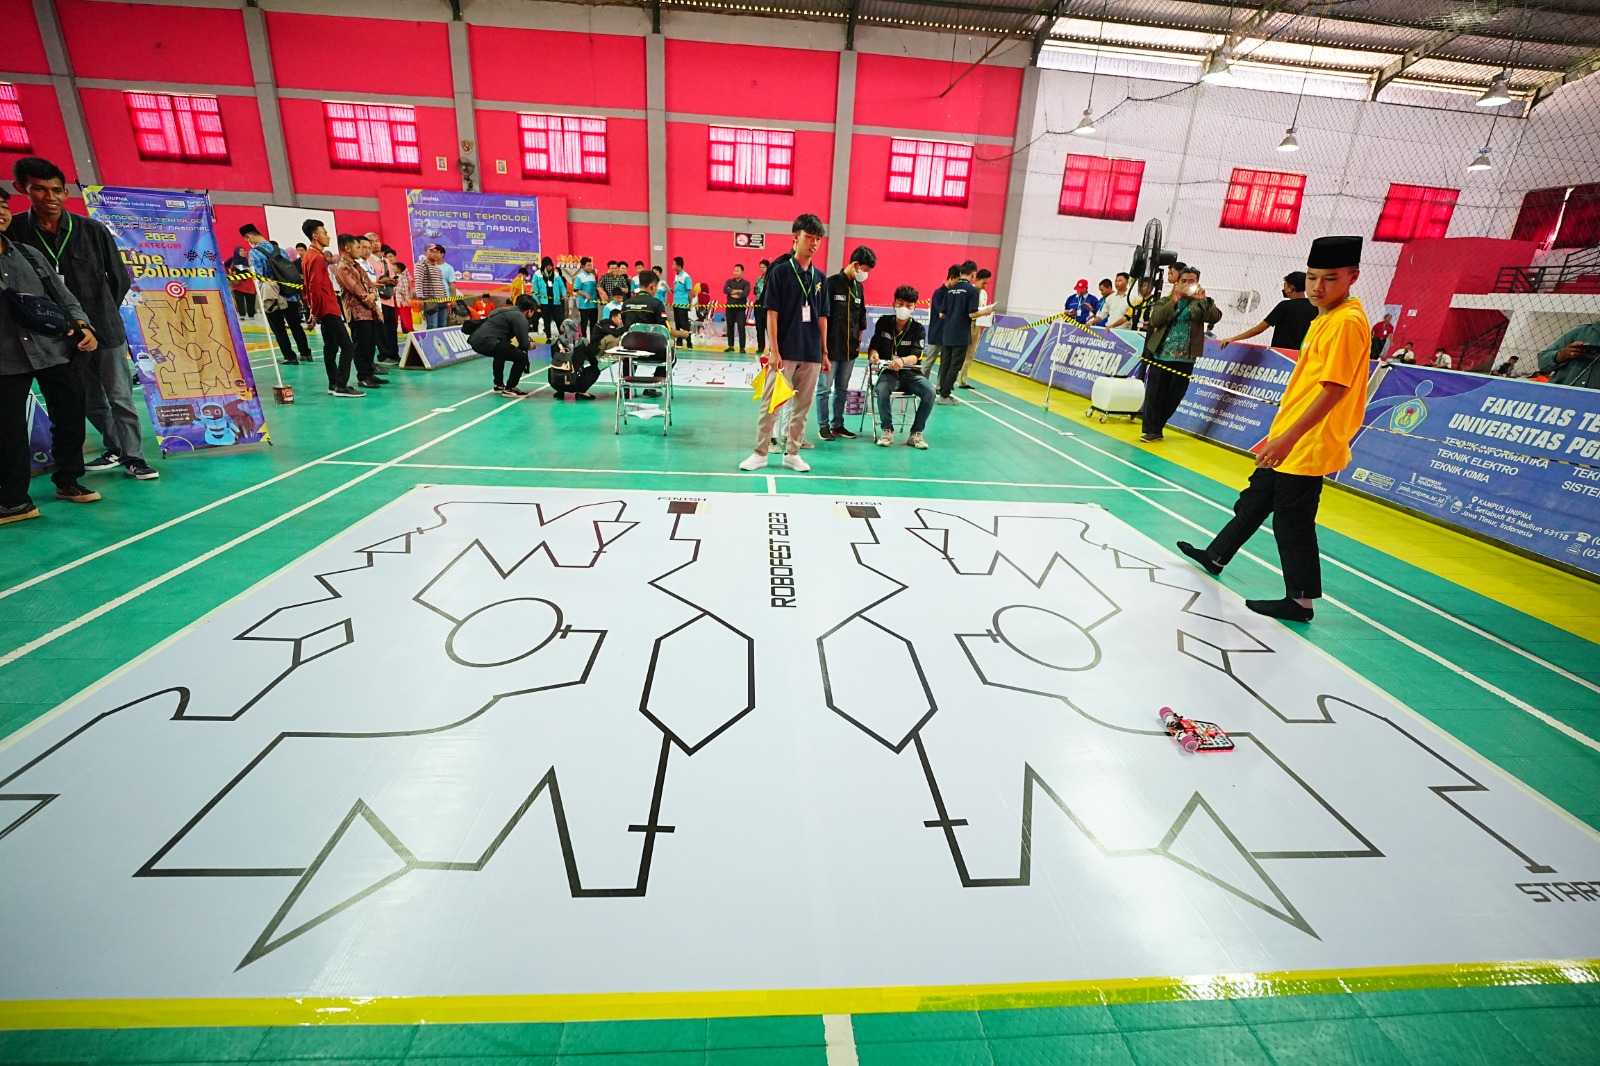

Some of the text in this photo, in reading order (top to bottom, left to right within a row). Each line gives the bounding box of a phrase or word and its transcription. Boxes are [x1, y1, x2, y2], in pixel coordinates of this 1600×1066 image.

[99, 213, 204, 224] KOMPETISI TEKNOLOGI
[415, 209, 530, 222] KOMPETISI TEKNOLOGI
[145, 232, 177, 242] 2023
[486, 225, 534, 234] NASIONAL
[120, 250, 165, 266] Line
[132, 265, 217, 279] Follower
[991, 326, 1029, 353] UNIPMA
[1068, 334, 1089, 345] SELAMAT
[1087, 337, 1110, 349] DATANG
[1069, 346, 1123, 375] CENDEKIA
[1226, 361, 1290, 386] PASCASARJA
[1195, 388, 1259, 410] Smart and Competitive
[1230, 382, 1250, 395] PGRI
[1250, 387, 1285, 402] MADIU
[1192, 402, 1209, 412] Bahasa
[1209, 407, 1219, 415] dan
[1219, 409, 1235, 419] Sastra
[1235, 413, 1261, 427] Indonesia
[1480, 396, 1600, 434] FAKULTAS TE
[1228, 421, 1246, 432] Sosial
[1448, 413, 1566, 451] UNIVERSITAS
[1436, 448, 1519, 476] TEKNIK ELEKTRO
[1444, 436, 1549, 469] TEKNIK INFORMATIKA
[1430, 459, 1491, 484] TEKNIK KIMIA
[1398, 485, 1445, 504] pmb.unipma.ac.id
[1561, 480, 1600, 498] SISTE
[1477, 499, 1532, 521] KAMPUS UNIPMA
[1460, 510, 1533, 539] Jawa Timur, Indonesia
[1475, 505, 1506, 521] Setiabudi
[1505, 516, 1515, 524] 85
[1515, 518, 1543, 533] Madiun
[1544, 528, 1570, 541] 63118
[768, 511, 797, 608] ROBOFEST 2023
